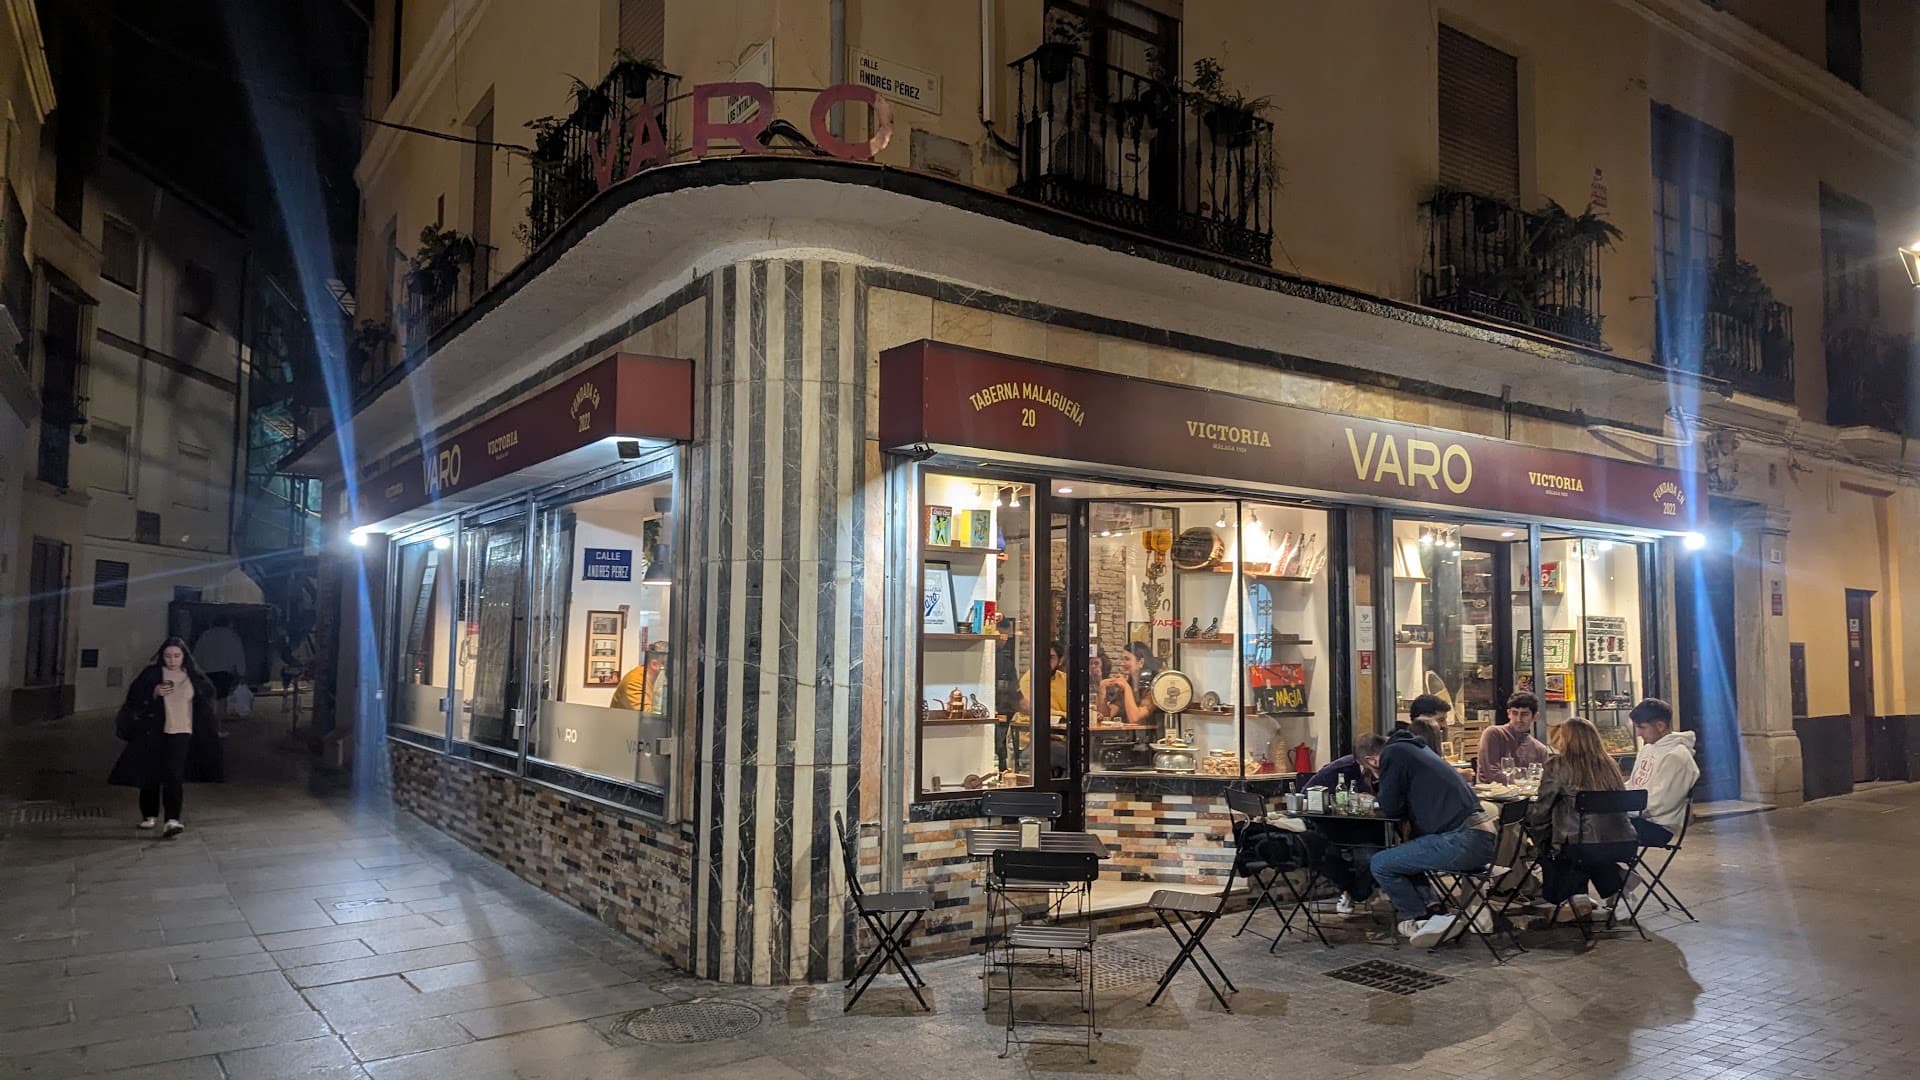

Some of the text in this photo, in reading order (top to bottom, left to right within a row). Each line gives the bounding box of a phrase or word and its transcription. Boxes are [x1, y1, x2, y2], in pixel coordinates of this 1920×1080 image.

[860, 57, 879, 70] CALLE
[894, 80, 920, 100] PÉREZ
[588, 82, 893, 191] VARO
[968, 382, 1085, 427] TABERNA MALAGUEÑA
[1021, 408, 1036, 427] 20
[487, 430, 519, 455] VICTORIA
[1186, 421, 1272, 448] VICTORIA
[422, 444, 462, 496] VARO
[1344, 428, 1473, 494] VARO
[1528, 471, 1584, 492] VICTORIA
[1653, 481, 1677, 502] FUNDADA
[1663, 502, 1676, 515] 2022
[595, 551, 622, 561] CALLE
[1275, 687, 1304, 708] MAGIA
